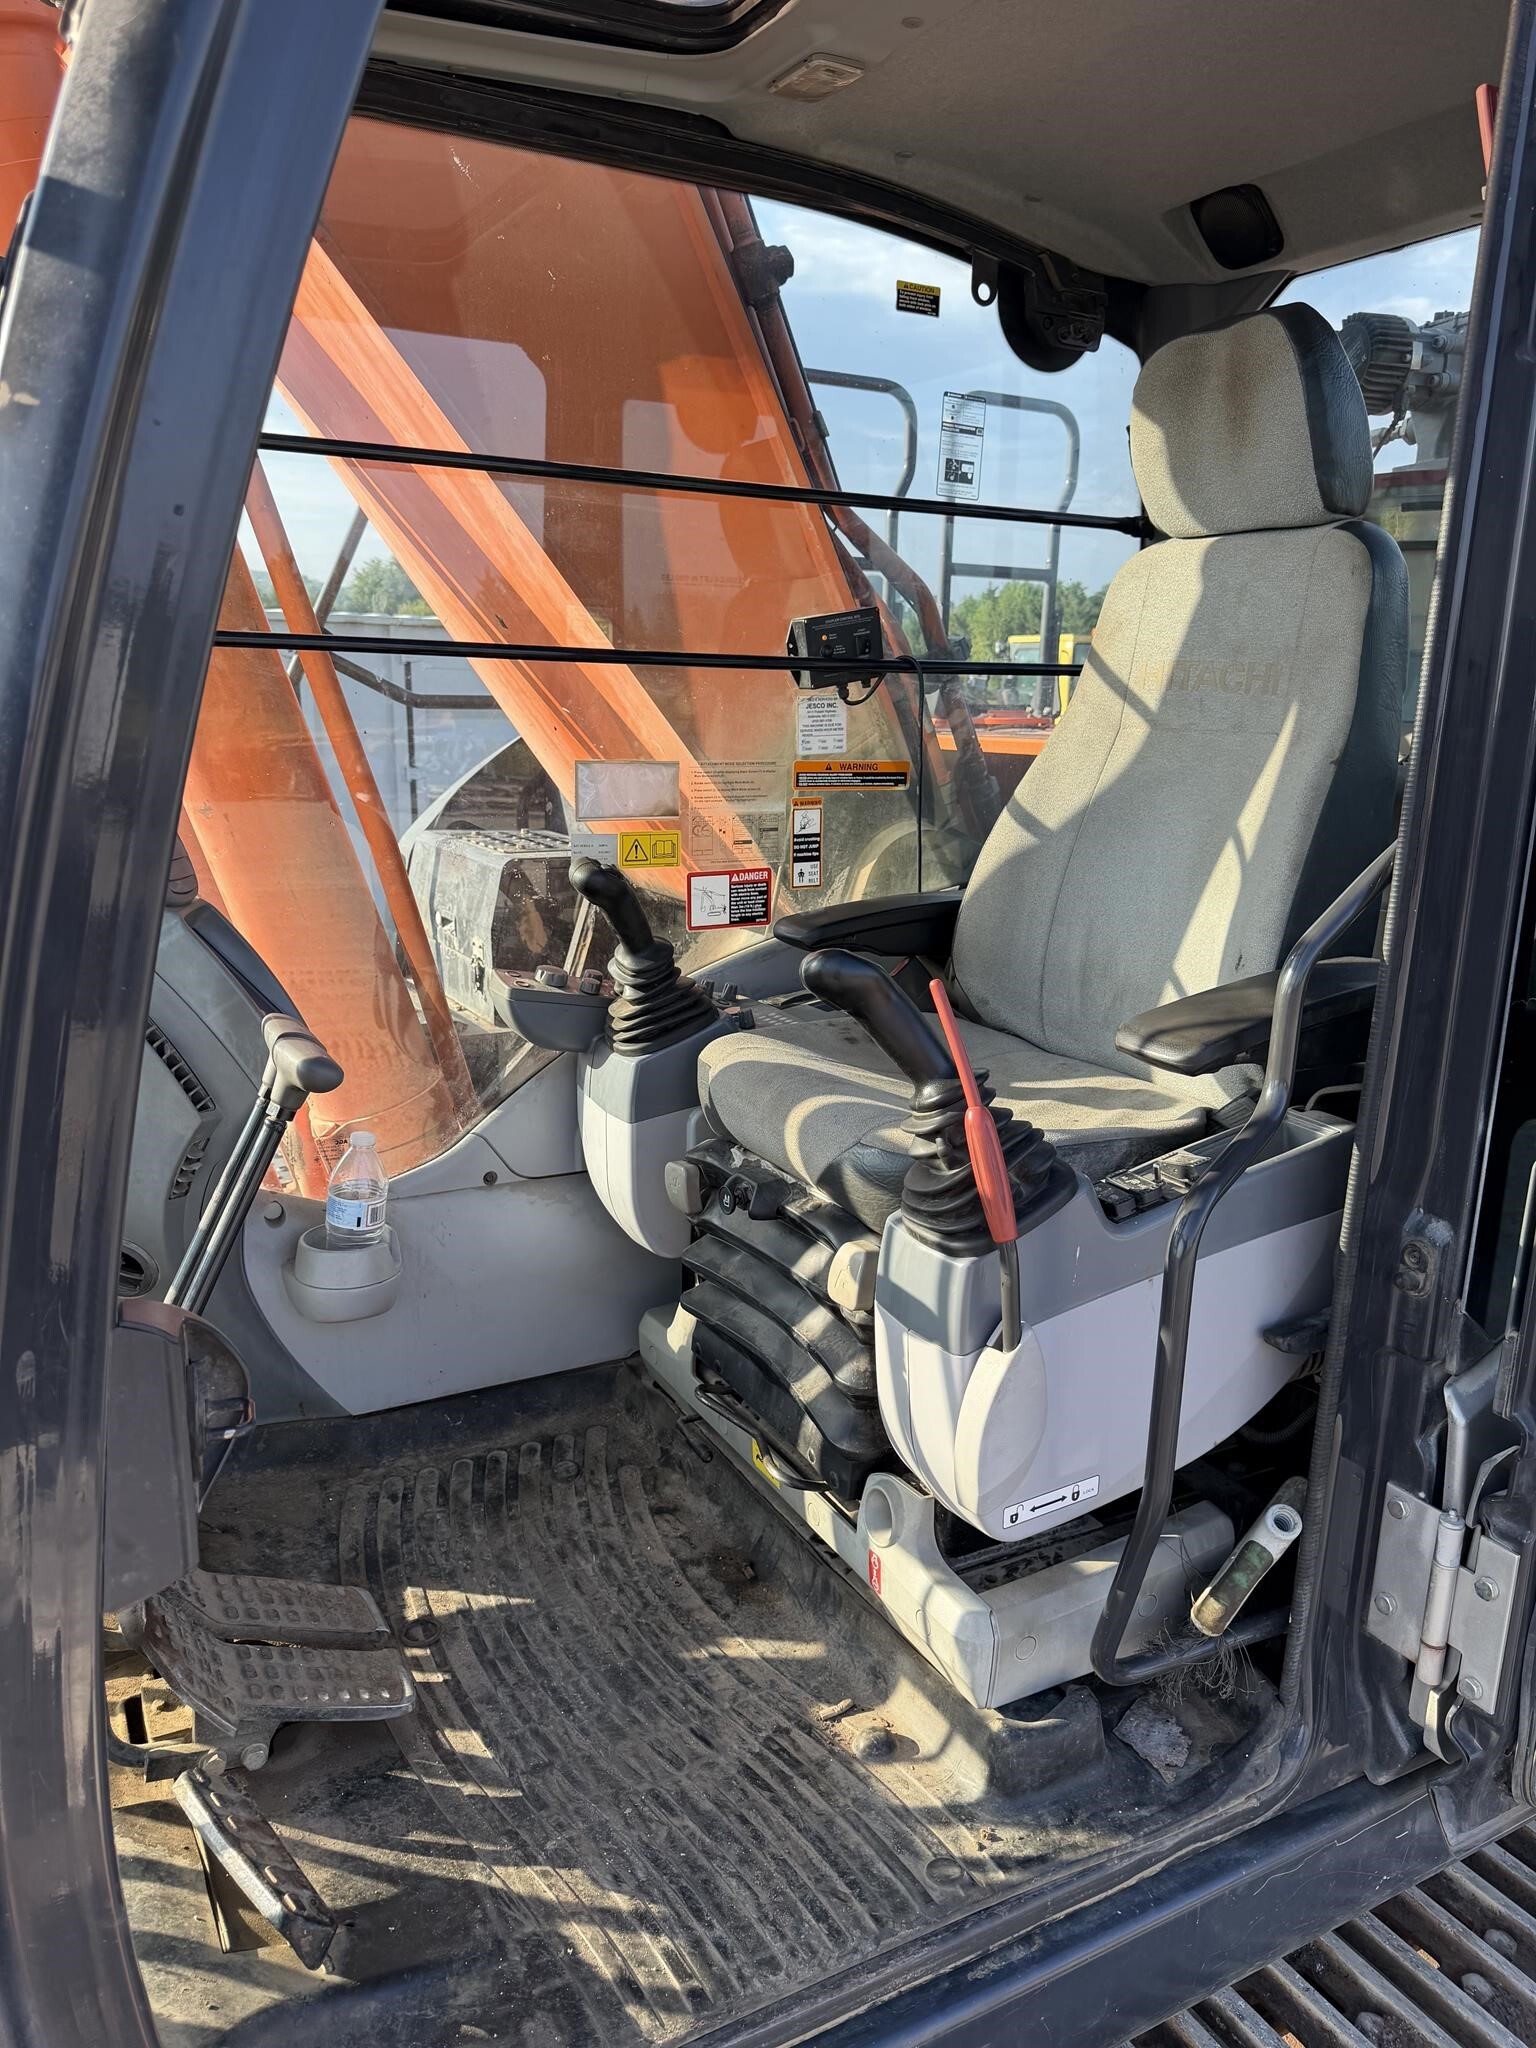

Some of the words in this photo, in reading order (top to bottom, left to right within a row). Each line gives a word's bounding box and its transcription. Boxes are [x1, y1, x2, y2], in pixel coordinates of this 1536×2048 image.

[909, 284, 935, 293] CAUTION
[840, 763, 878, 771] WARNING
[740, 871, 769, 881] DANGER
[1083, 1487, 1095, 1495] LOCK
